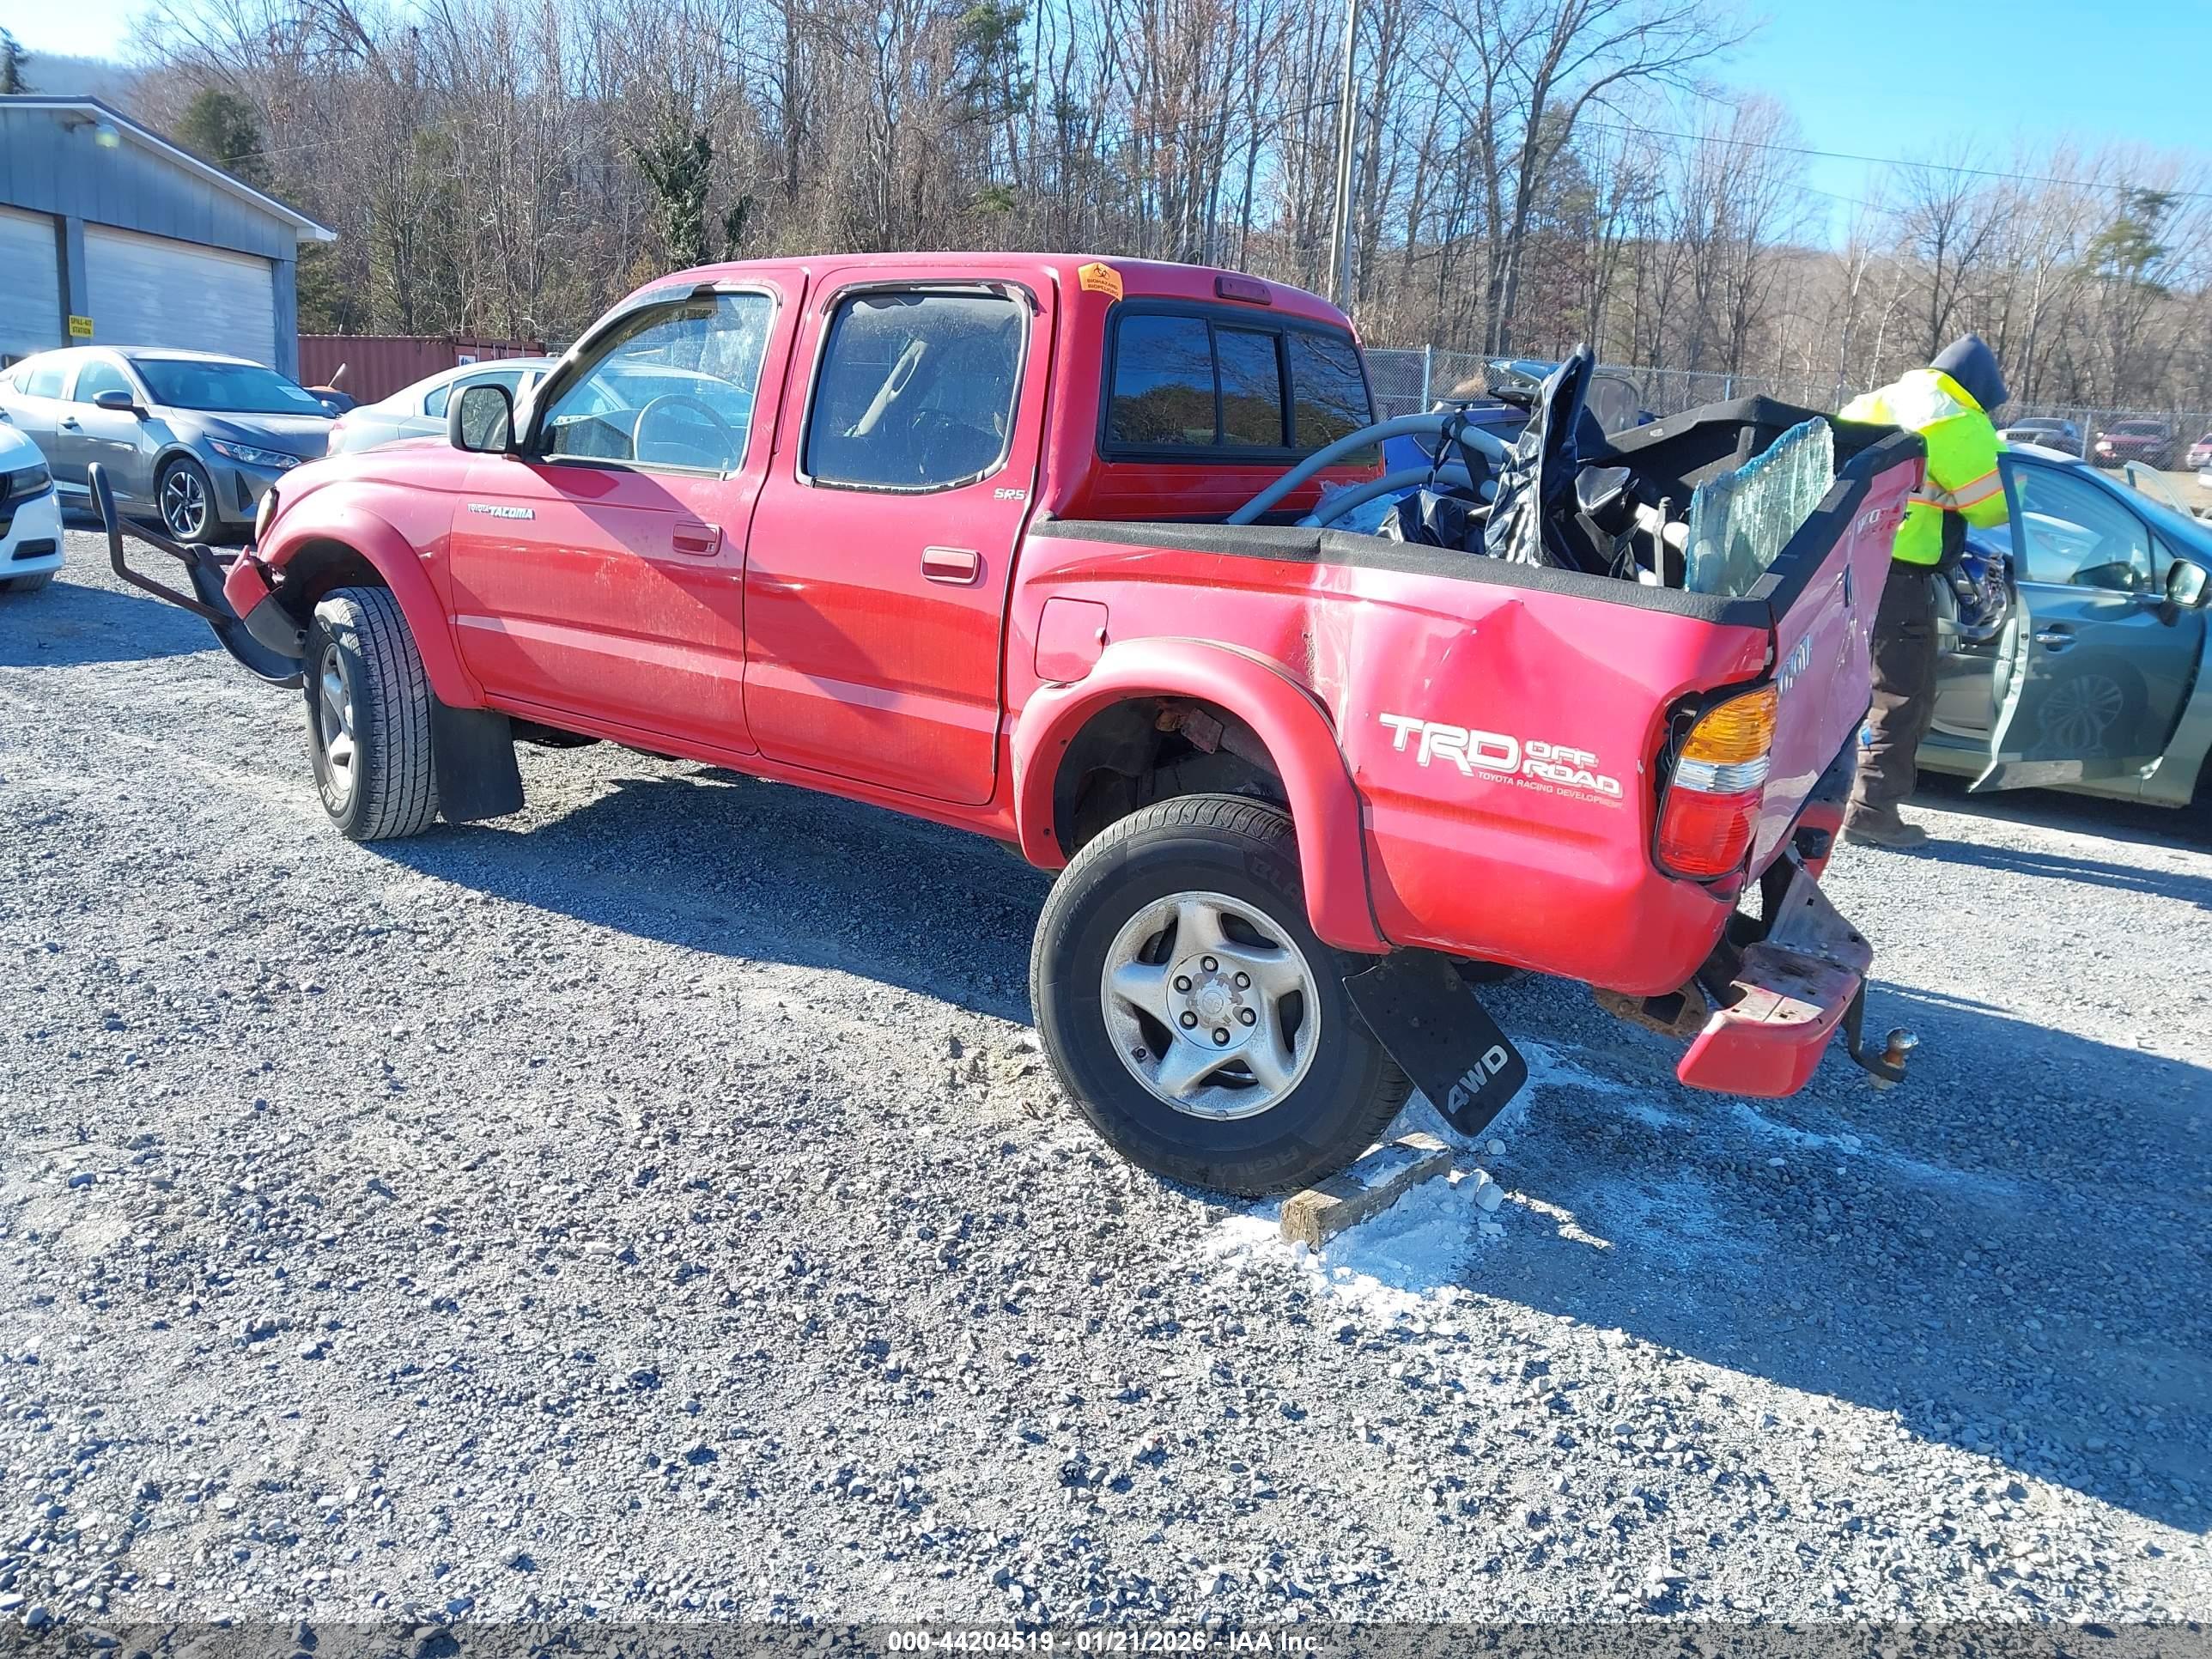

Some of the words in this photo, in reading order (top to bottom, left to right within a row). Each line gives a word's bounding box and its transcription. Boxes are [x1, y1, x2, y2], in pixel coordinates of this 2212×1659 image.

[1086, 278, 1119, 290] BIOHAZARD
[994, 488, 1026, 500] SR5
[489, 506, 536, 520] TACOMA
[1379, 712, 1521, 776] TRD
[1524, 740, 1599, 768] OFF
[1478, 771, 1514, 785] TOYOTA
[1516, 779, 1553, 793] RACING
[1522, 759, 1624, 799] ROAD
[1448, 1044, 1509, 1115] 4WD
